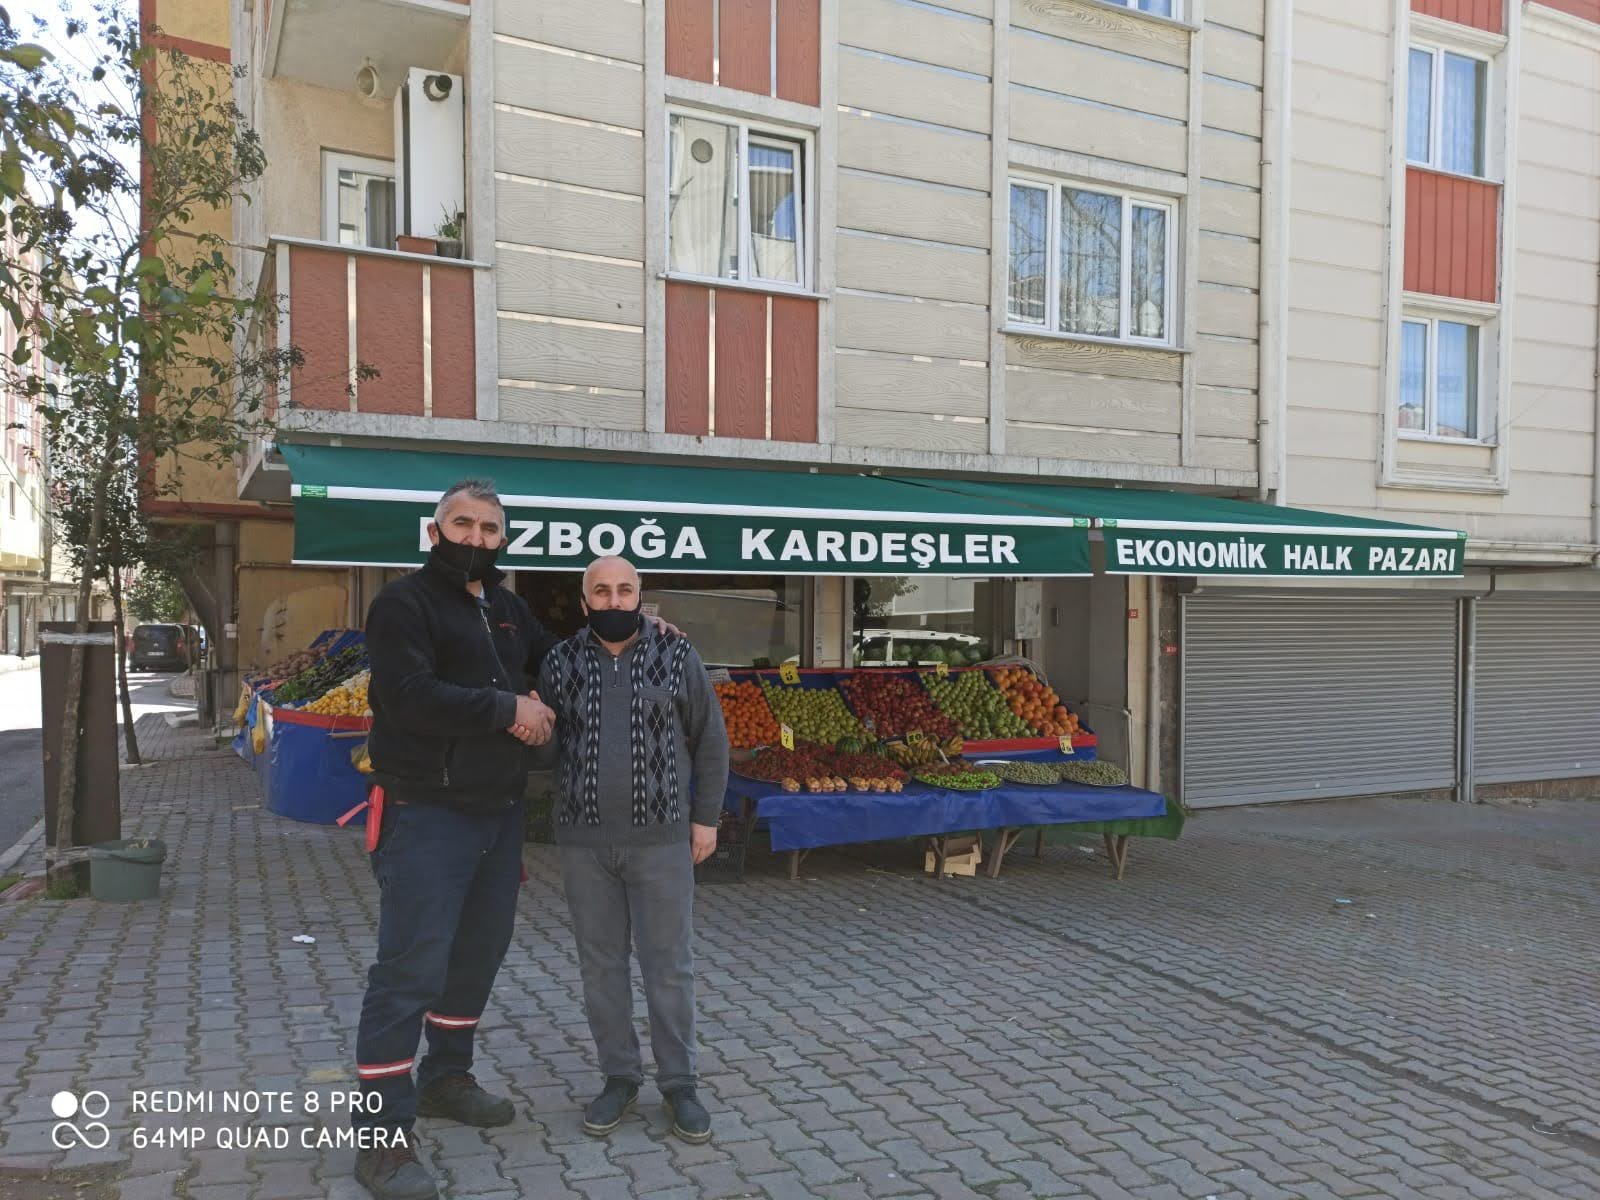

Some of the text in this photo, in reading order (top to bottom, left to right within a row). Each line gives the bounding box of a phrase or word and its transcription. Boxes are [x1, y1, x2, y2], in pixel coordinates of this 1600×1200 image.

[419, 516, 1021, 569] ZBOĞA KARDEŞLER
[1116, 536, 1456, 572] EKONOMİK HALK PAZARI
